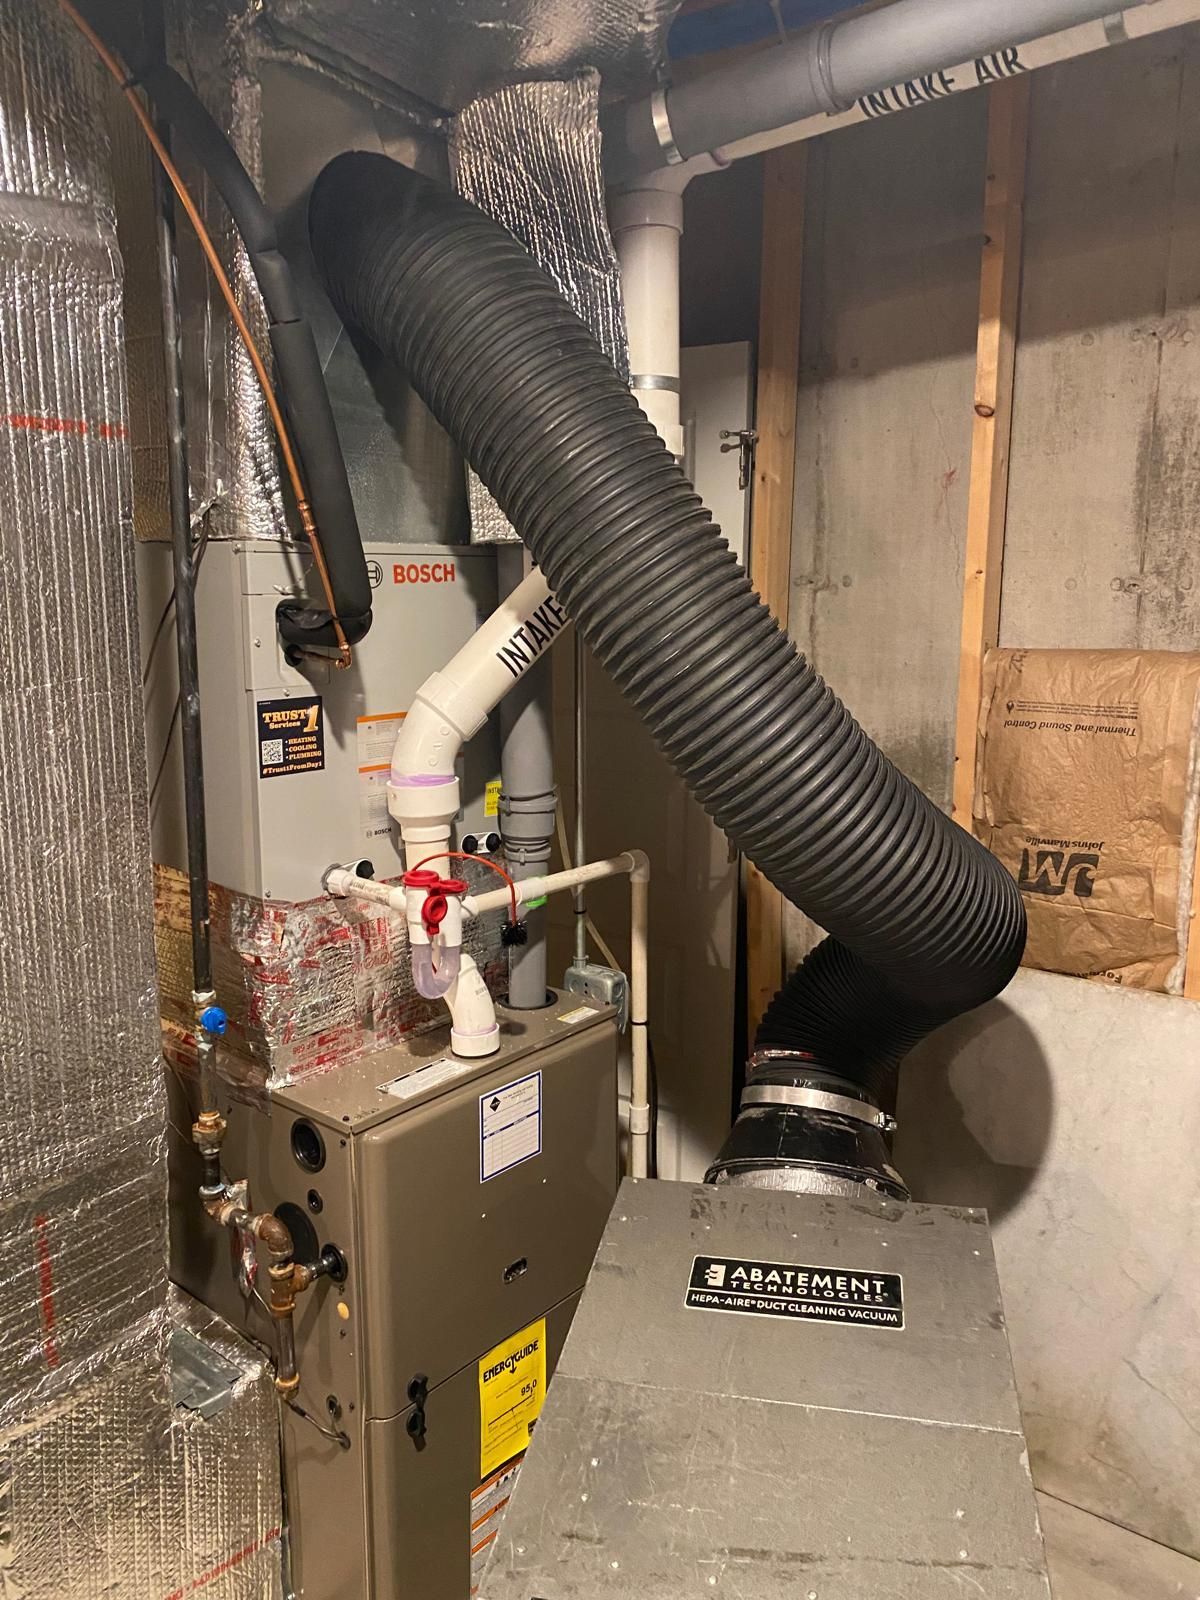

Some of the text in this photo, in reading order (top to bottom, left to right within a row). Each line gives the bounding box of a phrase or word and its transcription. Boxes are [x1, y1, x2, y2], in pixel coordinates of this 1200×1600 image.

[974, 46, 1028, 84] AIR
[392, 563, 456, 585] BOSCH
[496, 595, 570, 678] INTAKE
[262, 704, 320, 733] TRUST 1
[269, 720, 301, 730] Services
[1003, 719, 1138, 737] Thermal and Sound Control
[288, 735, 317, 745] HEATING
[288, 743, 317, 753] COOLING
[288, 750, 322, 761] PLUMBING
[374, 827, 392, 836] BOSCH
[1025, 835, 1105, 851] Johns Manville
[730, 1266, 885, 1294] ABATEMENT
[730, 1280, 883, 1303] TECHNOLOGIES
[756, 1300, 787, 1311] DUCT
[787, 1303, 846, 1317] CLEANING
[847, 1309, 898, 1322] VACUUM
[483, 1339, 539, 1383] ENERGYGUIDE
